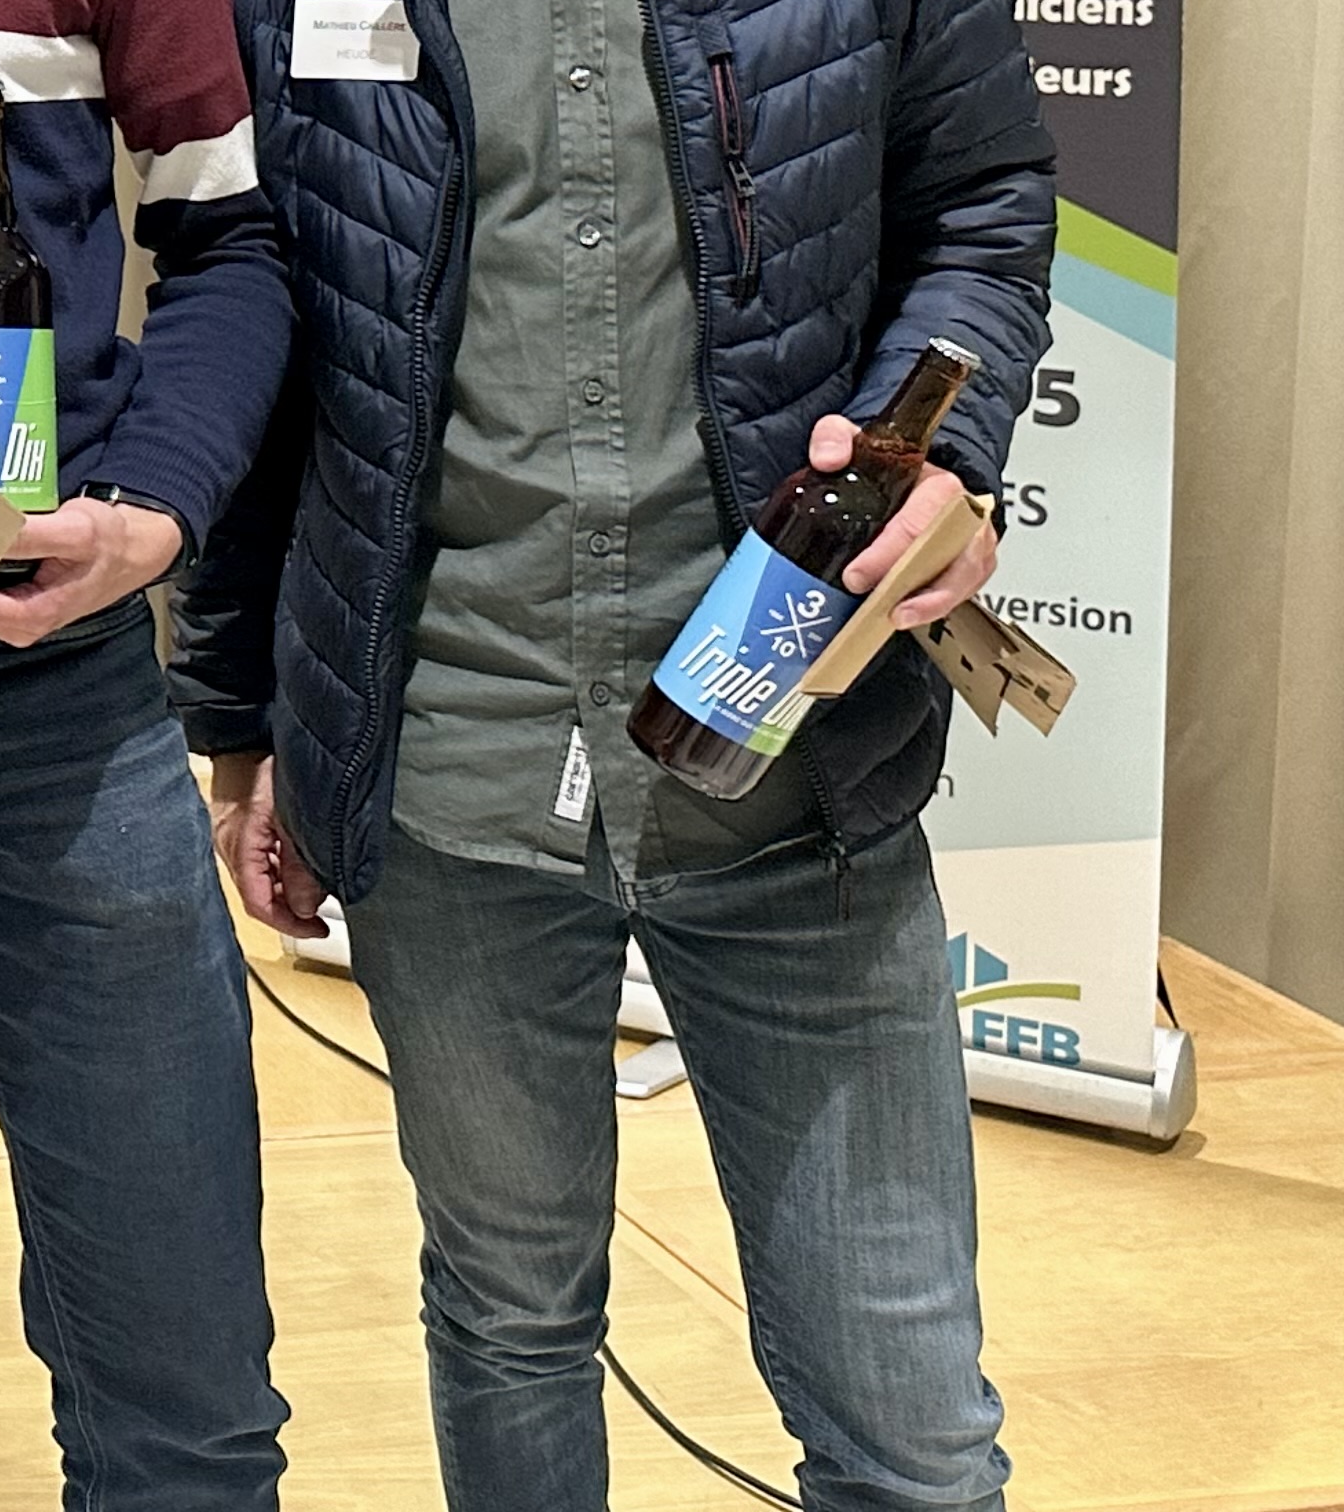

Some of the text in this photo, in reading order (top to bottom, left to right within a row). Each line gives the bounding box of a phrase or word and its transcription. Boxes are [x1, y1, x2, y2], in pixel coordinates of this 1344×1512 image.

[1029, 57, 1133, 98] eurs
[796, 590, 827, 619] 3
[972, 593, 1132, 635] version
[770, 636, 797, 659] 10
[677, 623, 779, 715] Triple
[972, 1008, 1081, 1067] FFB
